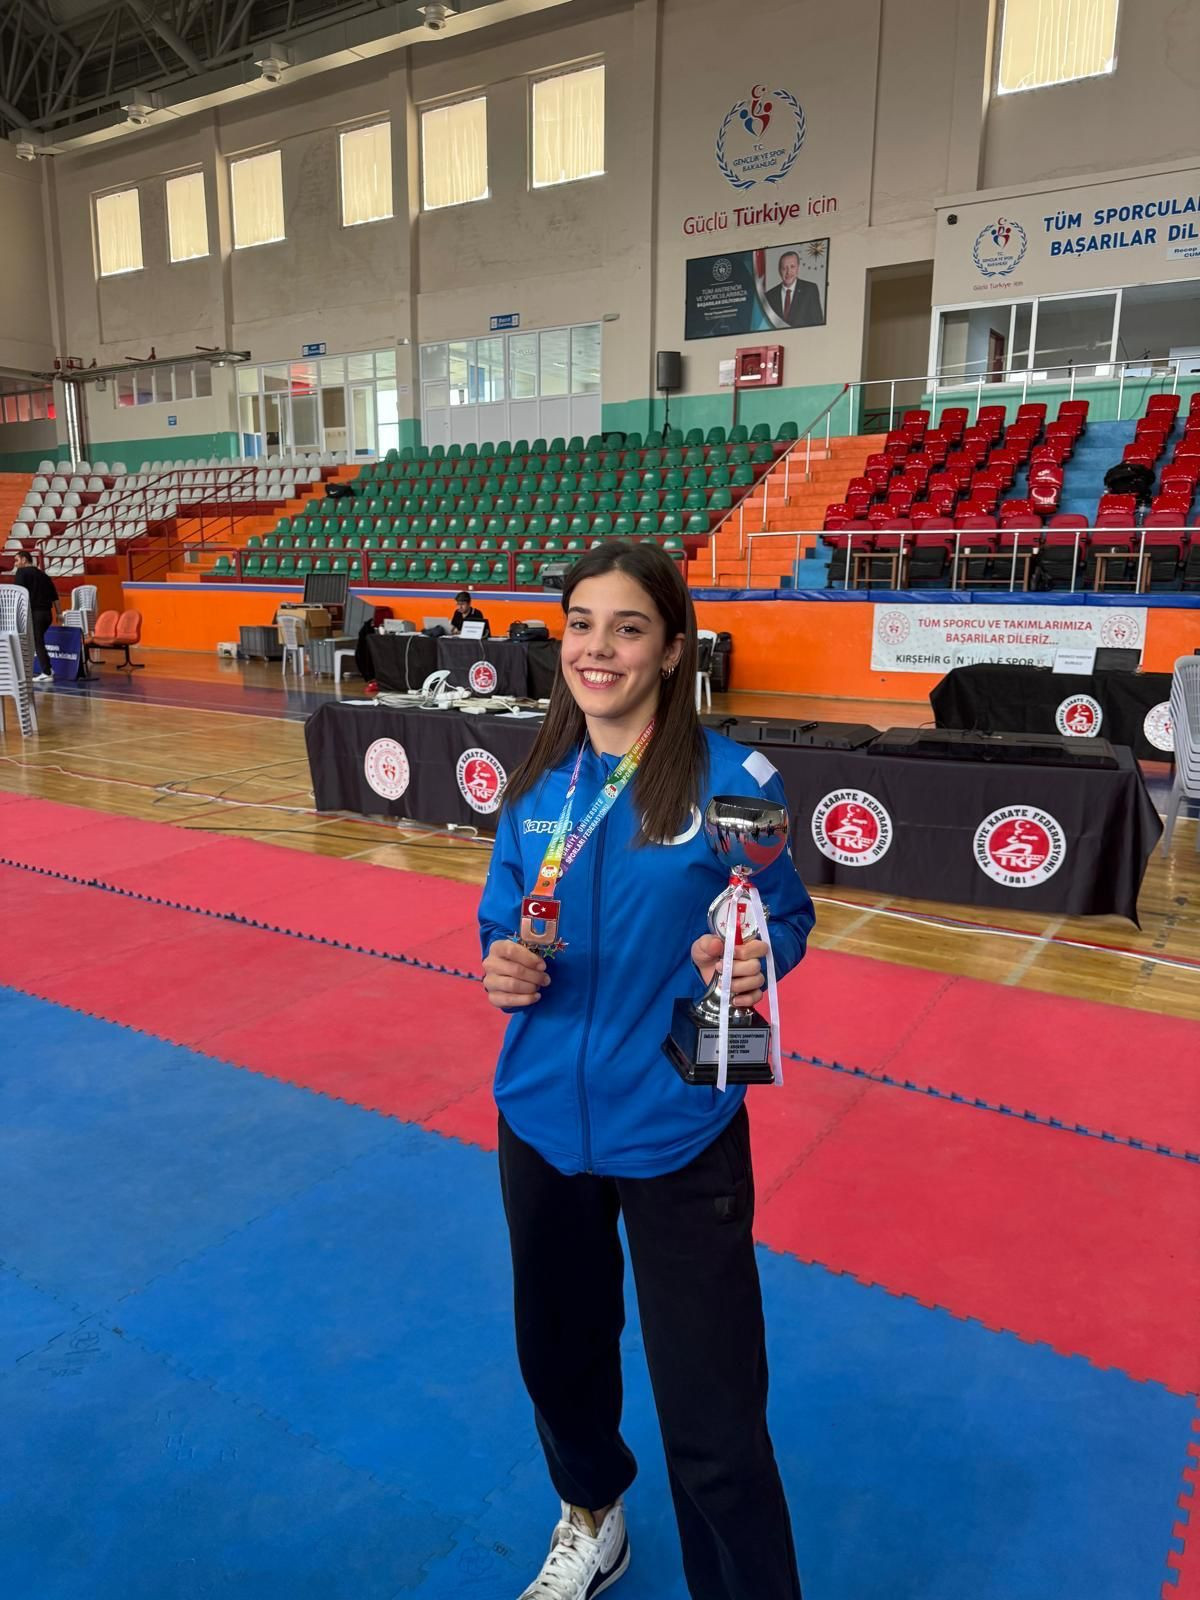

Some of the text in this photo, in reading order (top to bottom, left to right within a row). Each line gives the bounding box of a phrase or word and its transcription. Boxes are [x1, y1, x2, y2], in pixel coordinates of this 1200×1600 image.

[769, 149, 786, 158] SPOR
[683, 195, 837, 235] Güçlü Türkiye için
[1043, 211, 1082, 232] TÜM
[1050, 228, 1157, 257] BAŞARILAR
[918, 617, 1093, 631] TÜM SPORCU VE TAKIMLARIMIZA
[896, 653, 941, 665] KIRŞEHİR
[614, 754, 634, 779] TURKISH
[582, 803, 611, 843] FEDERASYONU
[814, 792, 889, 857] TÜRKİYE KARATE FEDERASYONU
[976, 808, 1062, 874] TÜRKİYE KARATE FEDERASYONU
